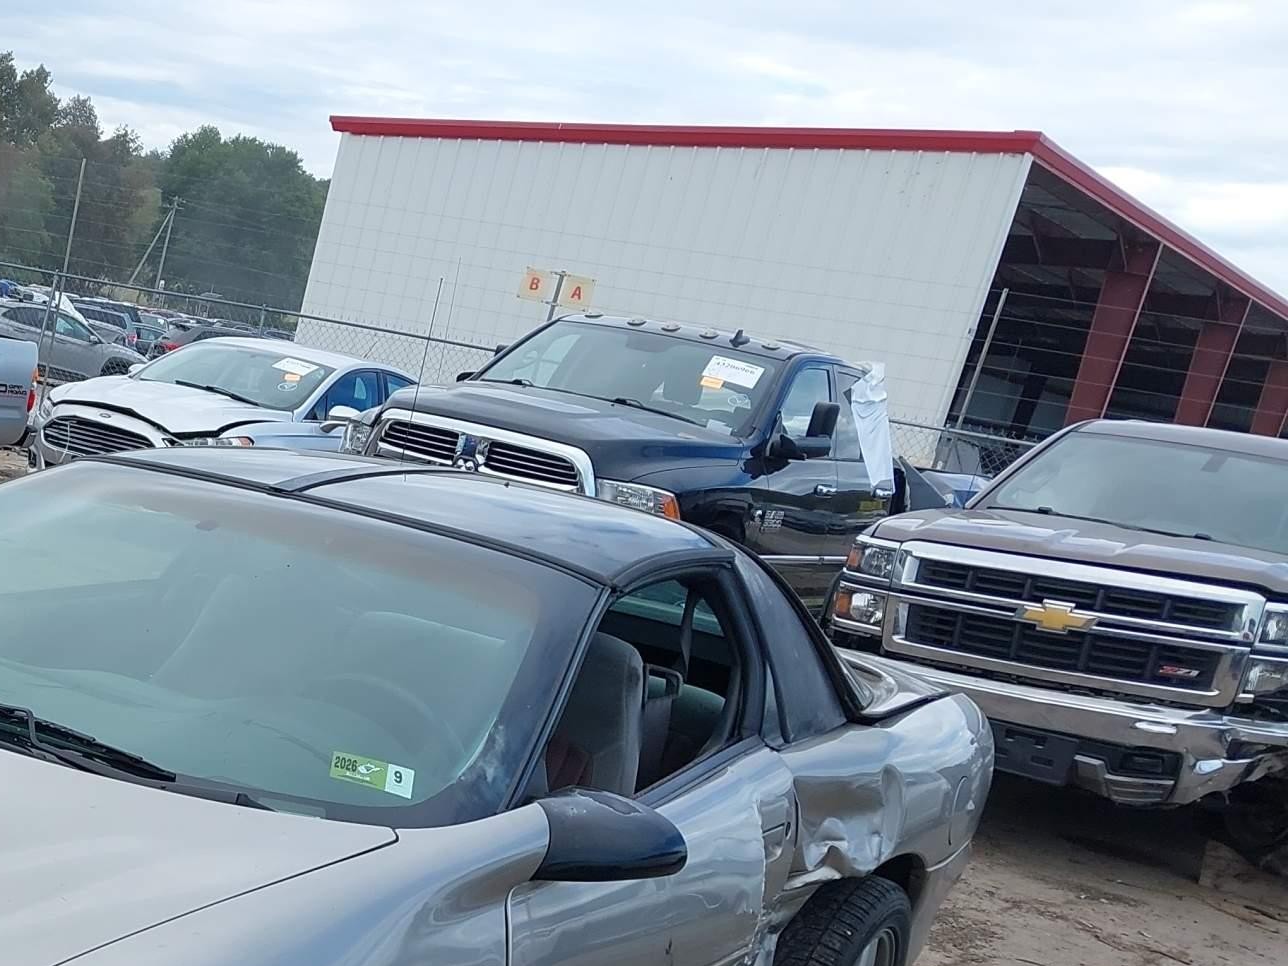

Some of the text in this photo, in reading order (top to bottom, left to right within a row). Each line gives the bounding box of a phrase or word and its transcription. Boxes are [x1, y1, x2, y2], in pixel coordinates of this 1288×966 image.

[529, 277, 540, 291] B
[571, 286, 582, 301] A
[334, 756, 358, 772] 2026
[394, 770, 403, 784] 9
